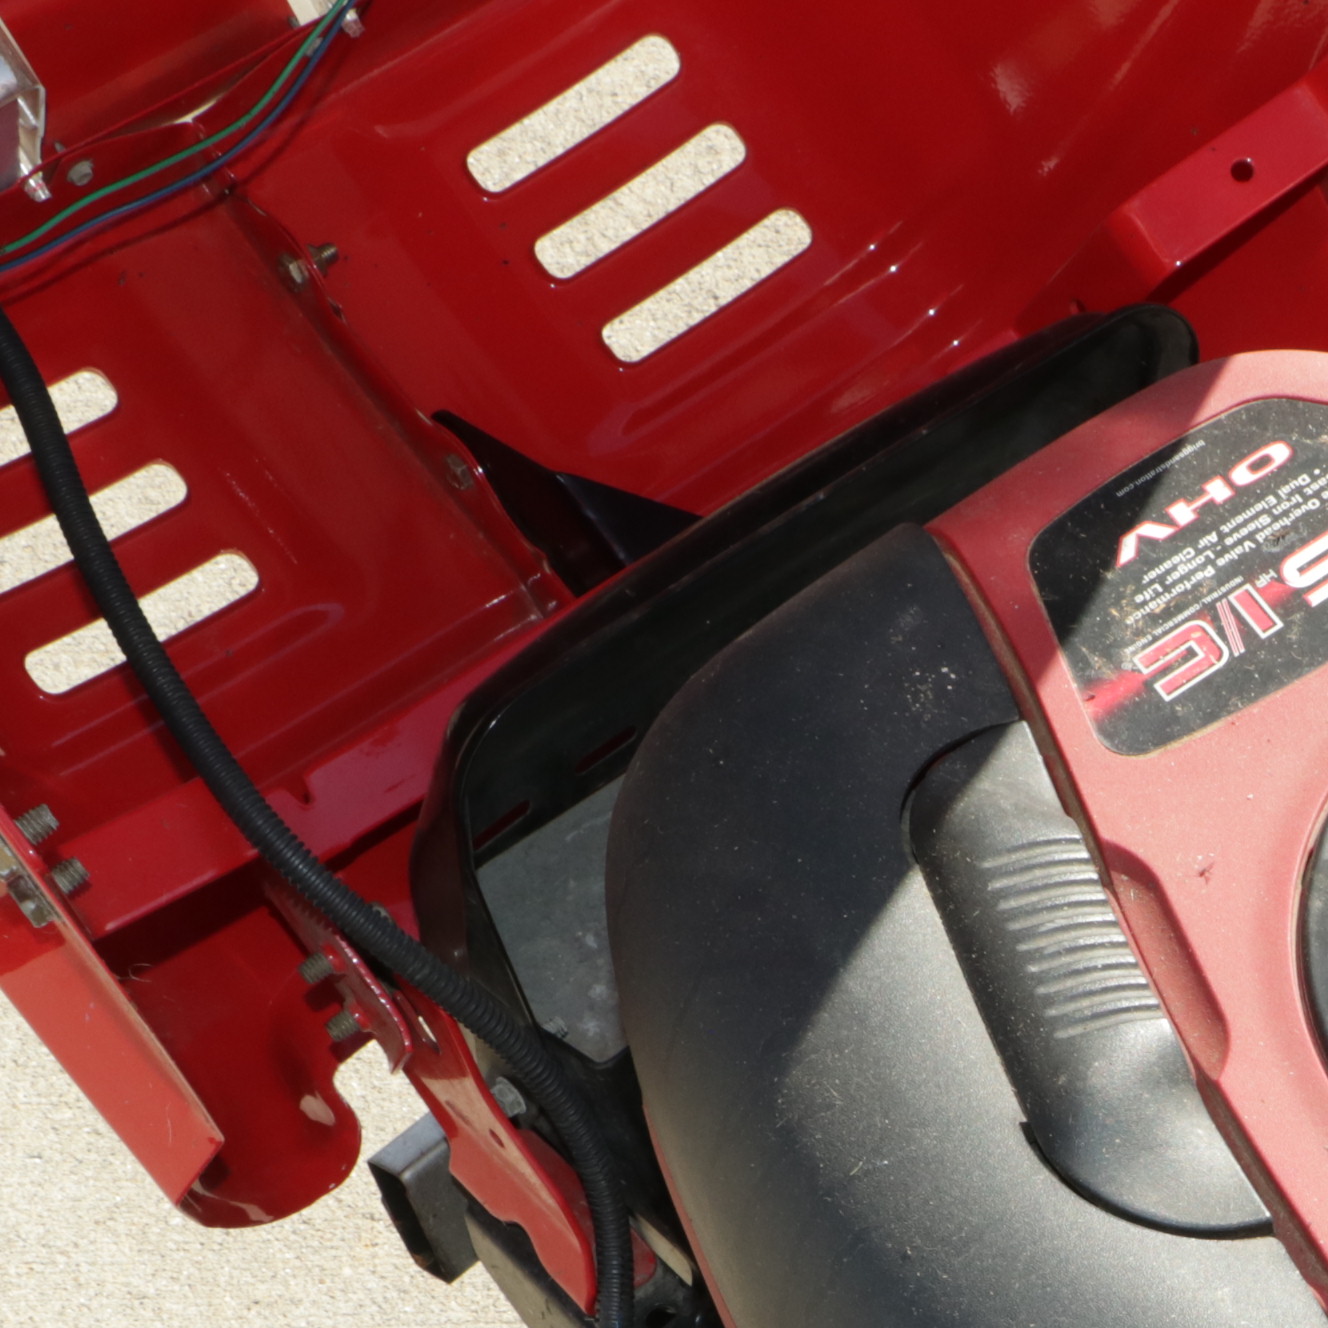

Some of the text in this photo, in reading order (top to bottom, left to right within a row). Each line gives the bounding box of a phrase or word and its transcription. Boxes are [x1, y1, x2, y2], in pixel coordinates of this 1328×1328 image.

[1115, 439, 1206, 497] briggsandstratton.com
[1115, 440, 1294, 568] OHV
[1255, 499, 1321, 544] Overhead
[1272, 495, 1305, 516] Iron
[1141, 472, 1311, 585] Dual Element Air Cleaner
[1223, 515, 1273, 546] Sleeve
[1165, 549, 1215, 585] Longer
[1215, 540, 1256, 567] Valve
[1124, 565, 1216, 625] Performance
[1134, 583, 1163, 603] Life
[1152, 575, 1244, 637] INDUSTRIAL/COMMERCIAL
